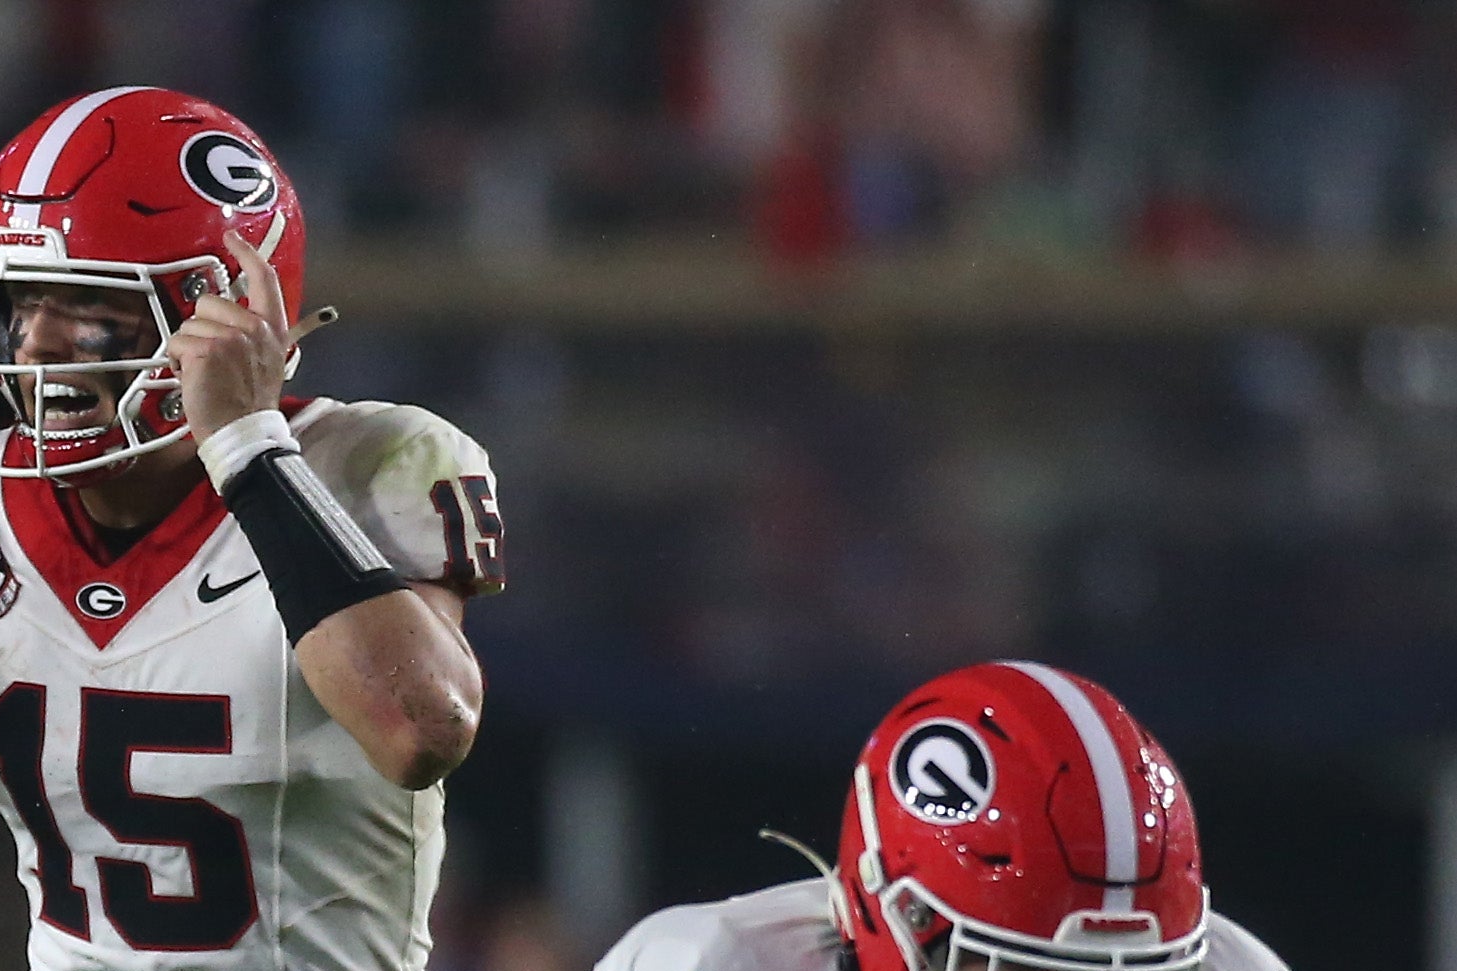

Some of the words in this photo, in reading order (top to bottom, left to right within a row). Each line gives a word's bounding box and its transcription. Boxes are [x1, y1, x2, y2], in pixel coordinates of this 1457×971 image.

[185, 134, 276, 207] G
[429, 474, 506, 583] 15
[77, 584, 125, 618] G
[896, 724, 988, 817] G
